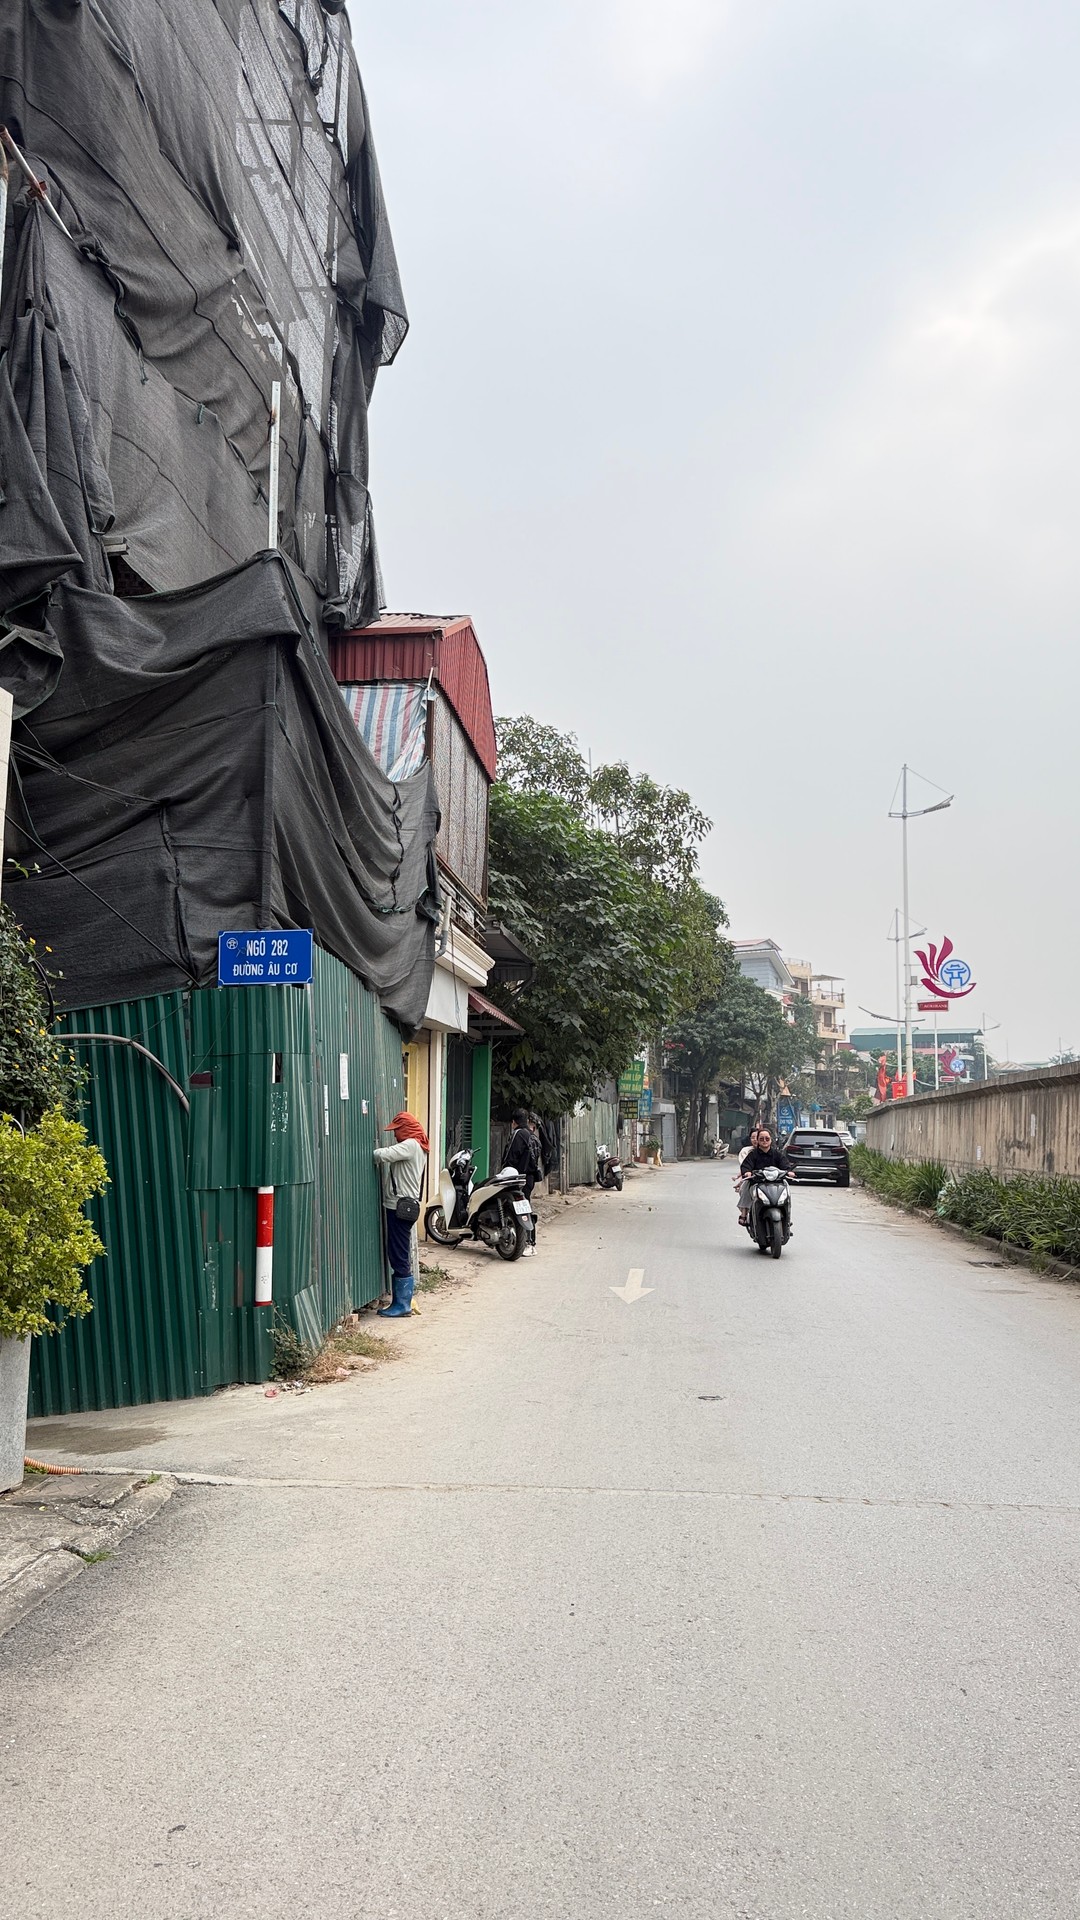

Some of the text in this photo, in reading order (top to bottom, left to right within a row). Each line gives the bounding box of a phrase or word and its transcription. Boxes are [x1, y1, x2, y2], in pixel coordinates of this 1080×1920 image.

[246, 937, 288, 956] NGÕ 282
[233, 961, 298, 976] ĐƯỜNG ÂU CƠ
